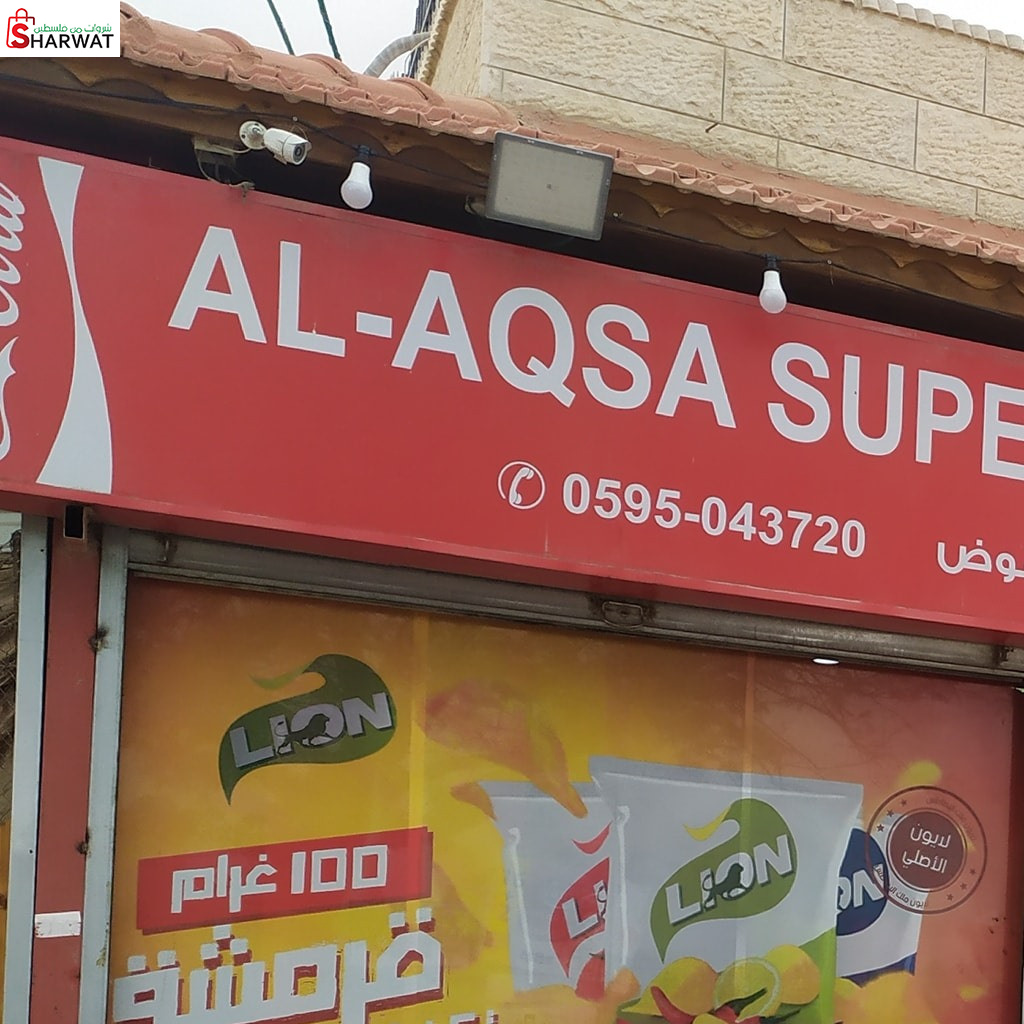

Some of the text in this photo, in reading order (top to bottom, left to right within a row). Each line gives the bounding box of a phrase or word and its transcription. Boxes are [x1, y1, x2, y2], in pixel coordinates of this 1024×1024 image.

[168, 225, 736, 428] AL-AQSA
[561, 473, 867, 559] 0595-043720
[229, 692, 396, 768] LION
[902, 849, 948, 874] الأصلي
[909, 823, 951, 849] لايون
[170, 853, 277, 914] غرام
[665, 835, 795, 925] LION
